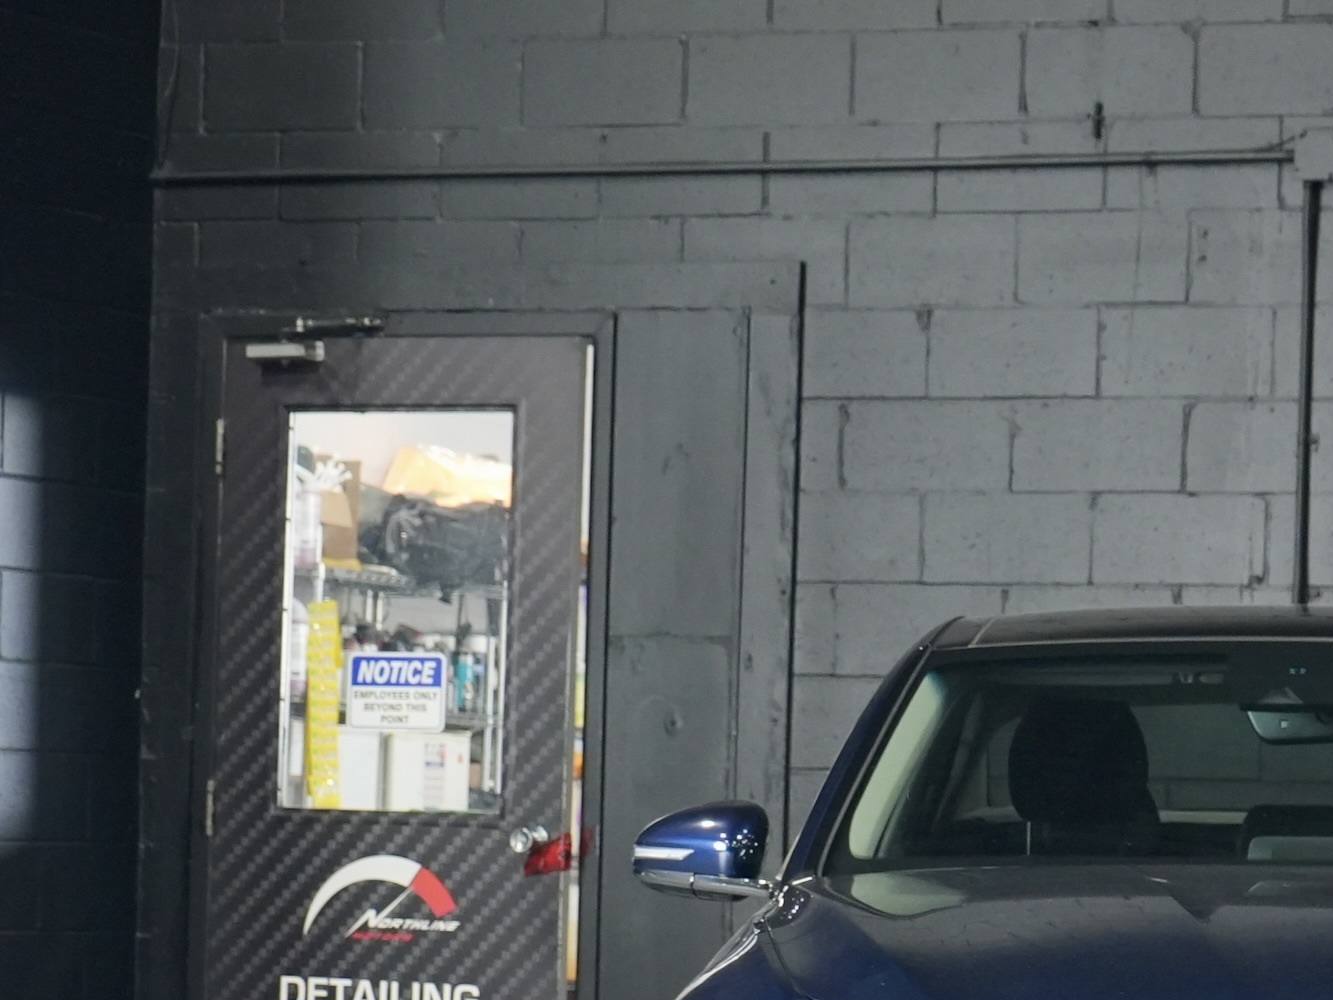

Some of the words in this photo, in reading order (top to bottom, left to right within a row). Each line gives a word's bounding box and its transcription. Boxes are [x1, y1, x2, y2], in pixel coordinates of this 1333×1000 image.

[357, 659, 437, 684] NOTICE
[354, 690, 410, 700] EMPLOYEES
[413, 691, 437, 701] ONLY
[364, 703, 403, 712] BEYOND
[406, 704, 427, 712] THIS
[380, 715, 409, 724] POINT
